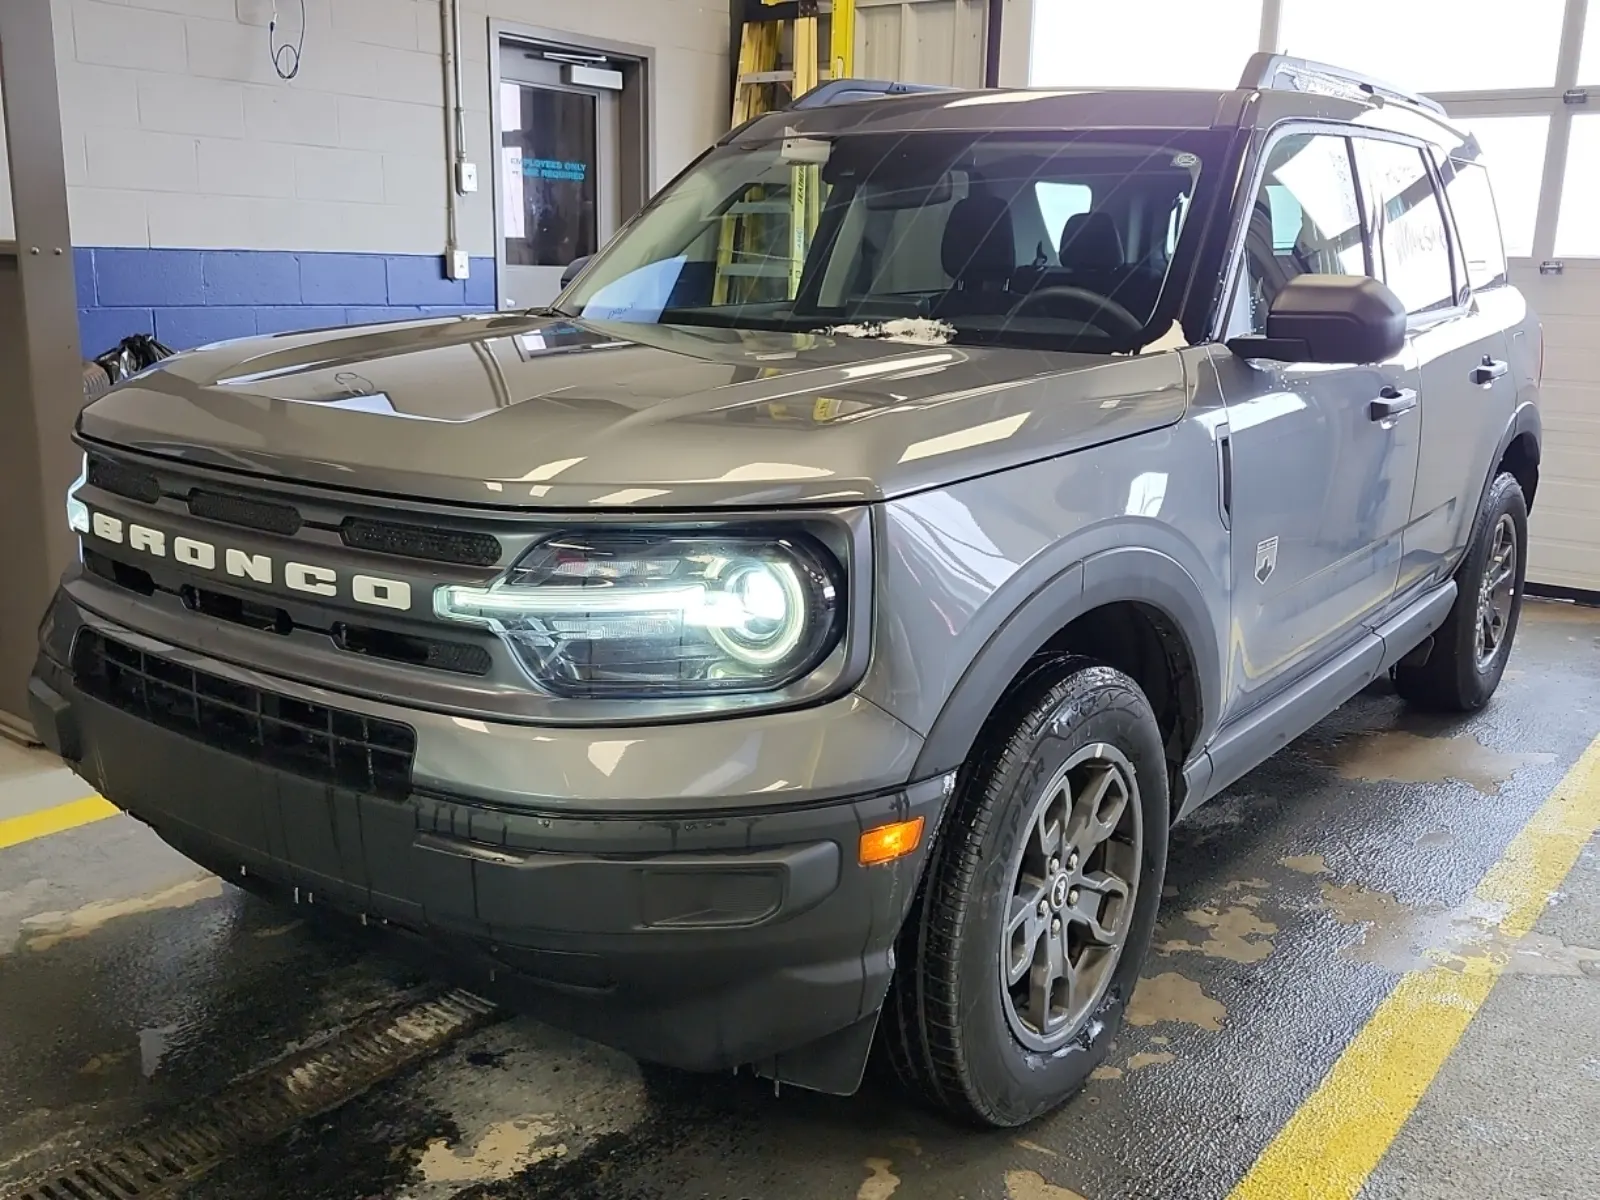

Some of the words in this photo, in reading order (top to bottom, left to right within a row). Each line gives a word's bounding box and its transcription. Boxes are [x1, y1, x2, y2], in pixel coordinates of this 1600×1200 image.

[541, 168, 585, 180] REQUIRED
[564, 162, 587, 171] ONLY
[93, 511, 412, 611] BRONCO
[988, 757, 1045, 897] OOPER
